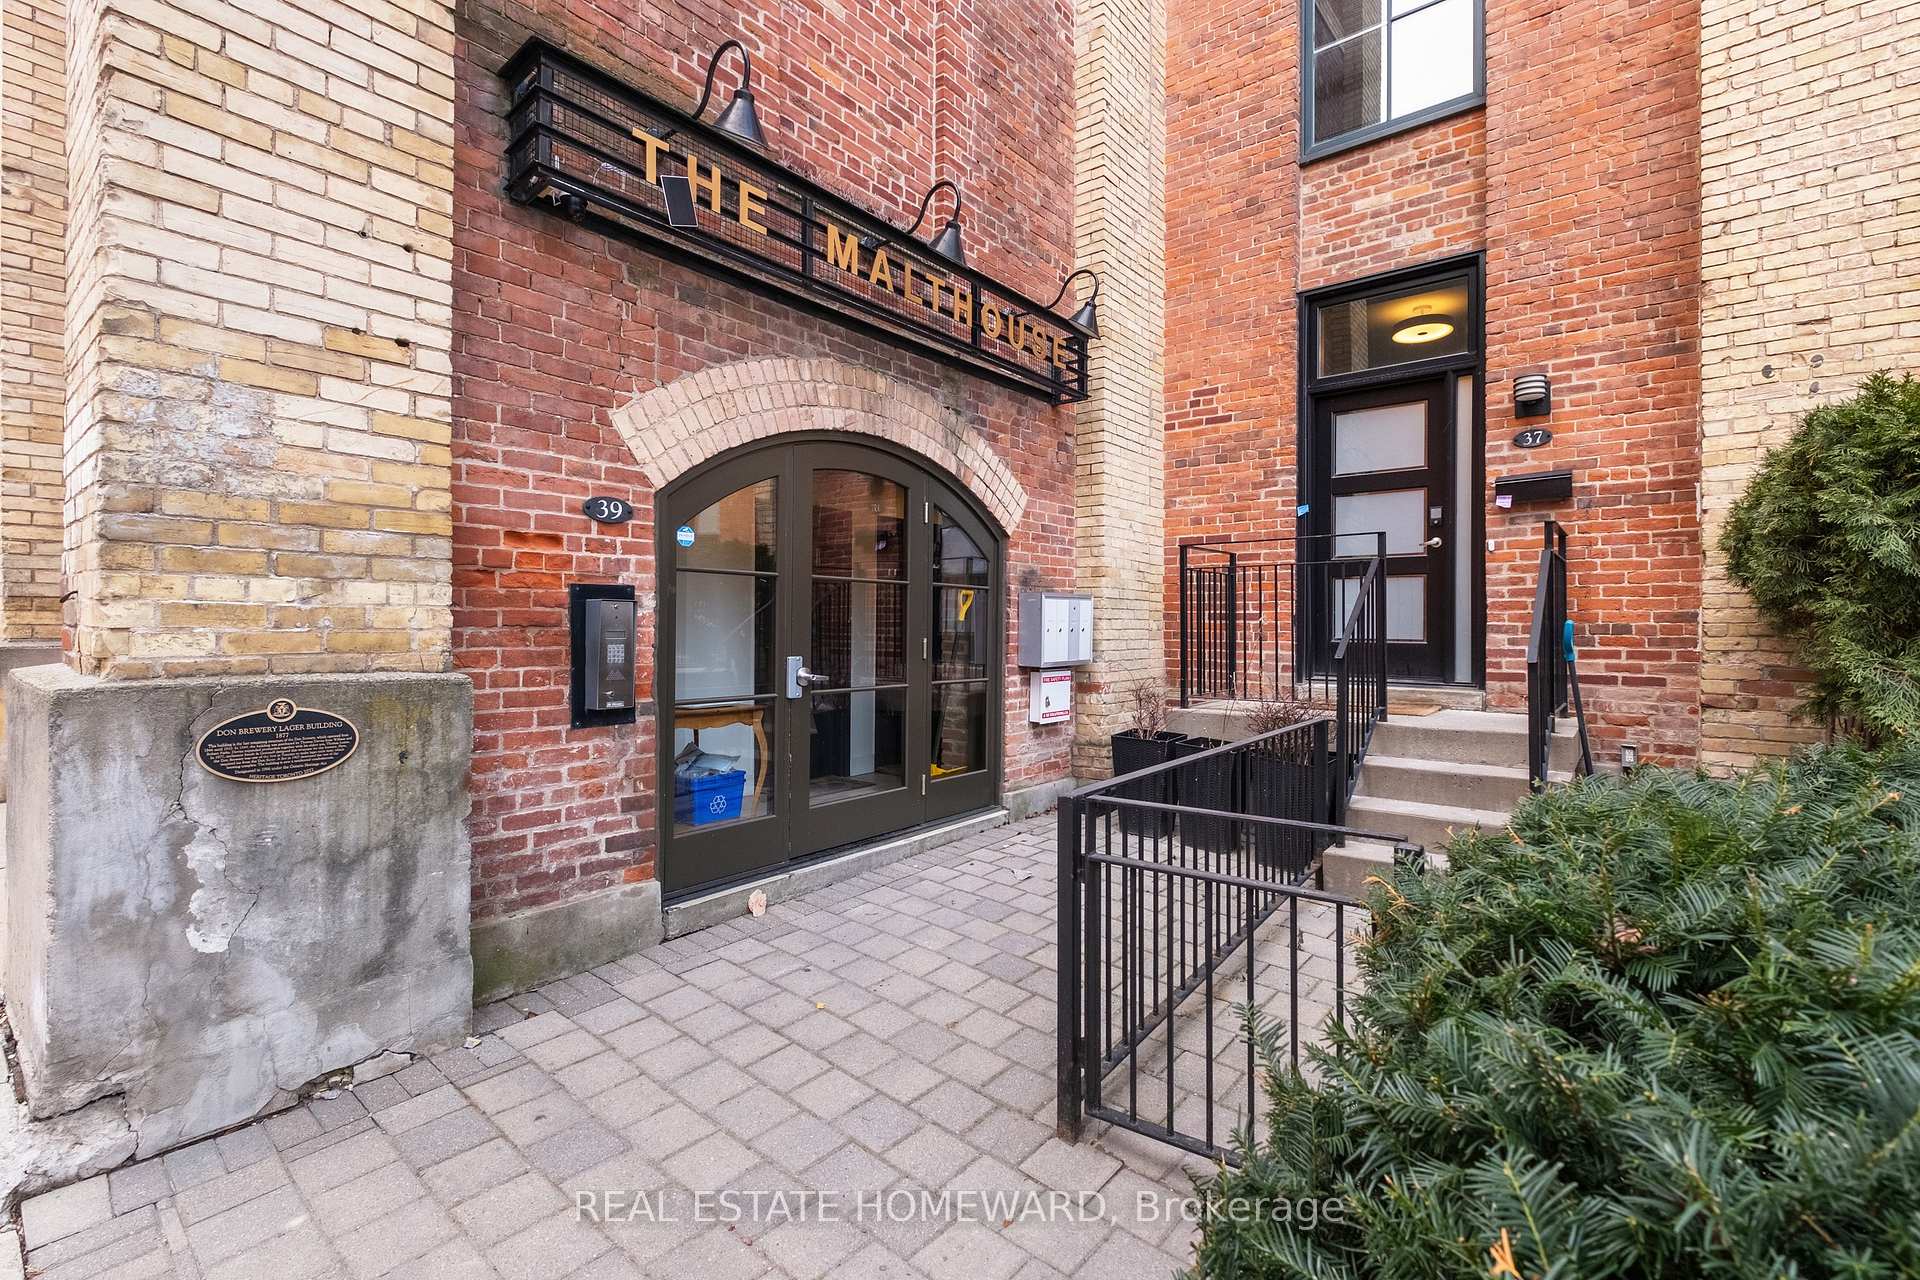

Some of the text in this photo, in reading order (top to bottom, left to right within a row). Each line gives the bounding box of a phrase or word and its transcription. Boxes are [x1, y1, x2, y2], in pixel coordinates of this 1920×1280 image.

[631, 126, 1069, 370] THE MALTHOUSE
[1522, 431, 1543, 445] 37
[596, 499, 623, 520] 39
[216, 721, 343, 737] DON BREWERY LAGER BUILDING
